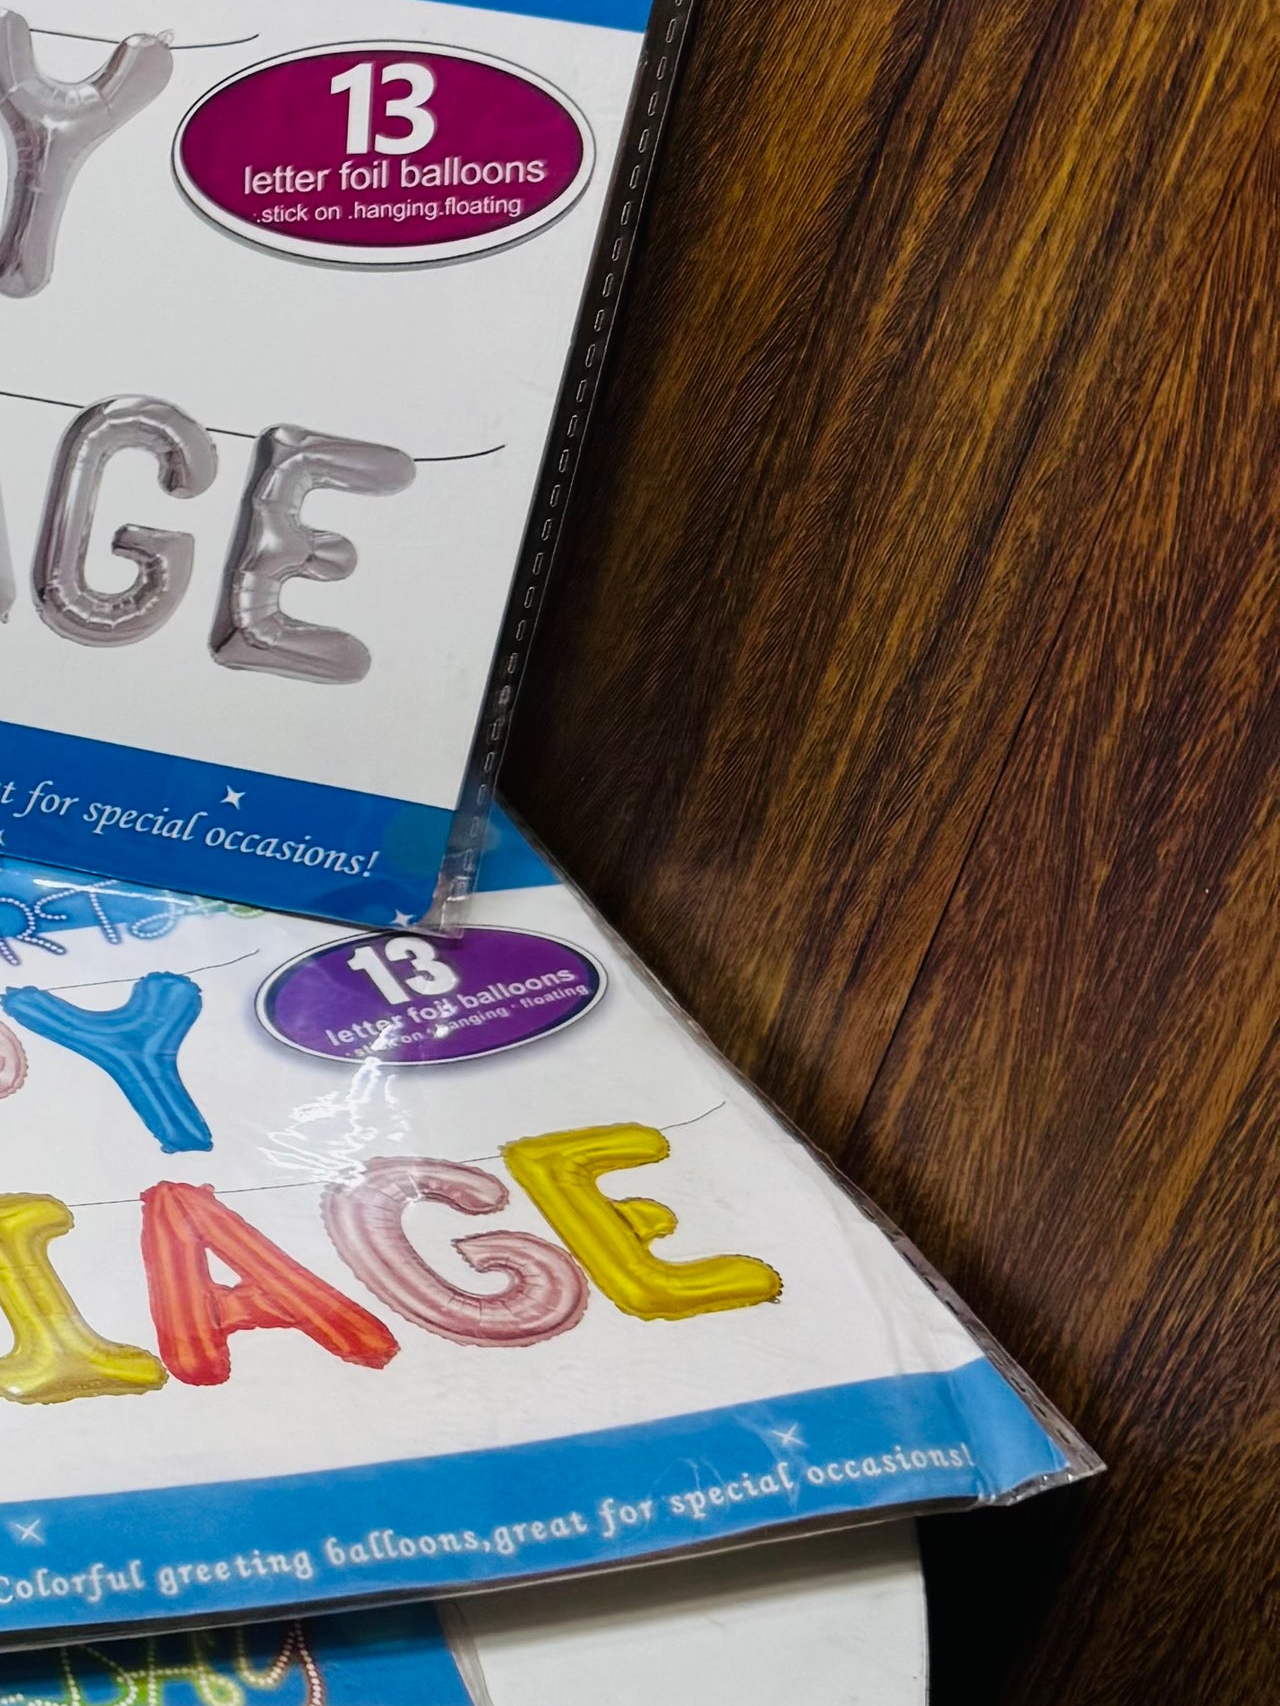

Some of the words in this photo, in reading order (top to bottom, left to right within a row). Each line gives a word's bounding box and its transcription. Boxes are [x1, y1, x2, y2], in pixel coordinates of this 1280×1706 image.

[330, 62, 437, 156] 13
[243, 164, 330, 195] letter
[339, 160, 389, 191] foil
[400, 157, 547, 188] balloons
[318, 206, 340, 220] on
[12, 780, 79, 817] for
[83, 800, 207, 842] special
[204, 827, 380, 878] occasions!
[325, 1013, 403, 1048] letter
[458, 968, 576, 1009] balloons
[347, 937, 459, 1005] 13
[520, 983, 589, 1009] floating
[159, 1549, 311, 1595] greeting
[600, 1497, 654, 1537] for
[669, 1462, 793, 1519] special
[808, 1443, 974, 1485] occasions!
